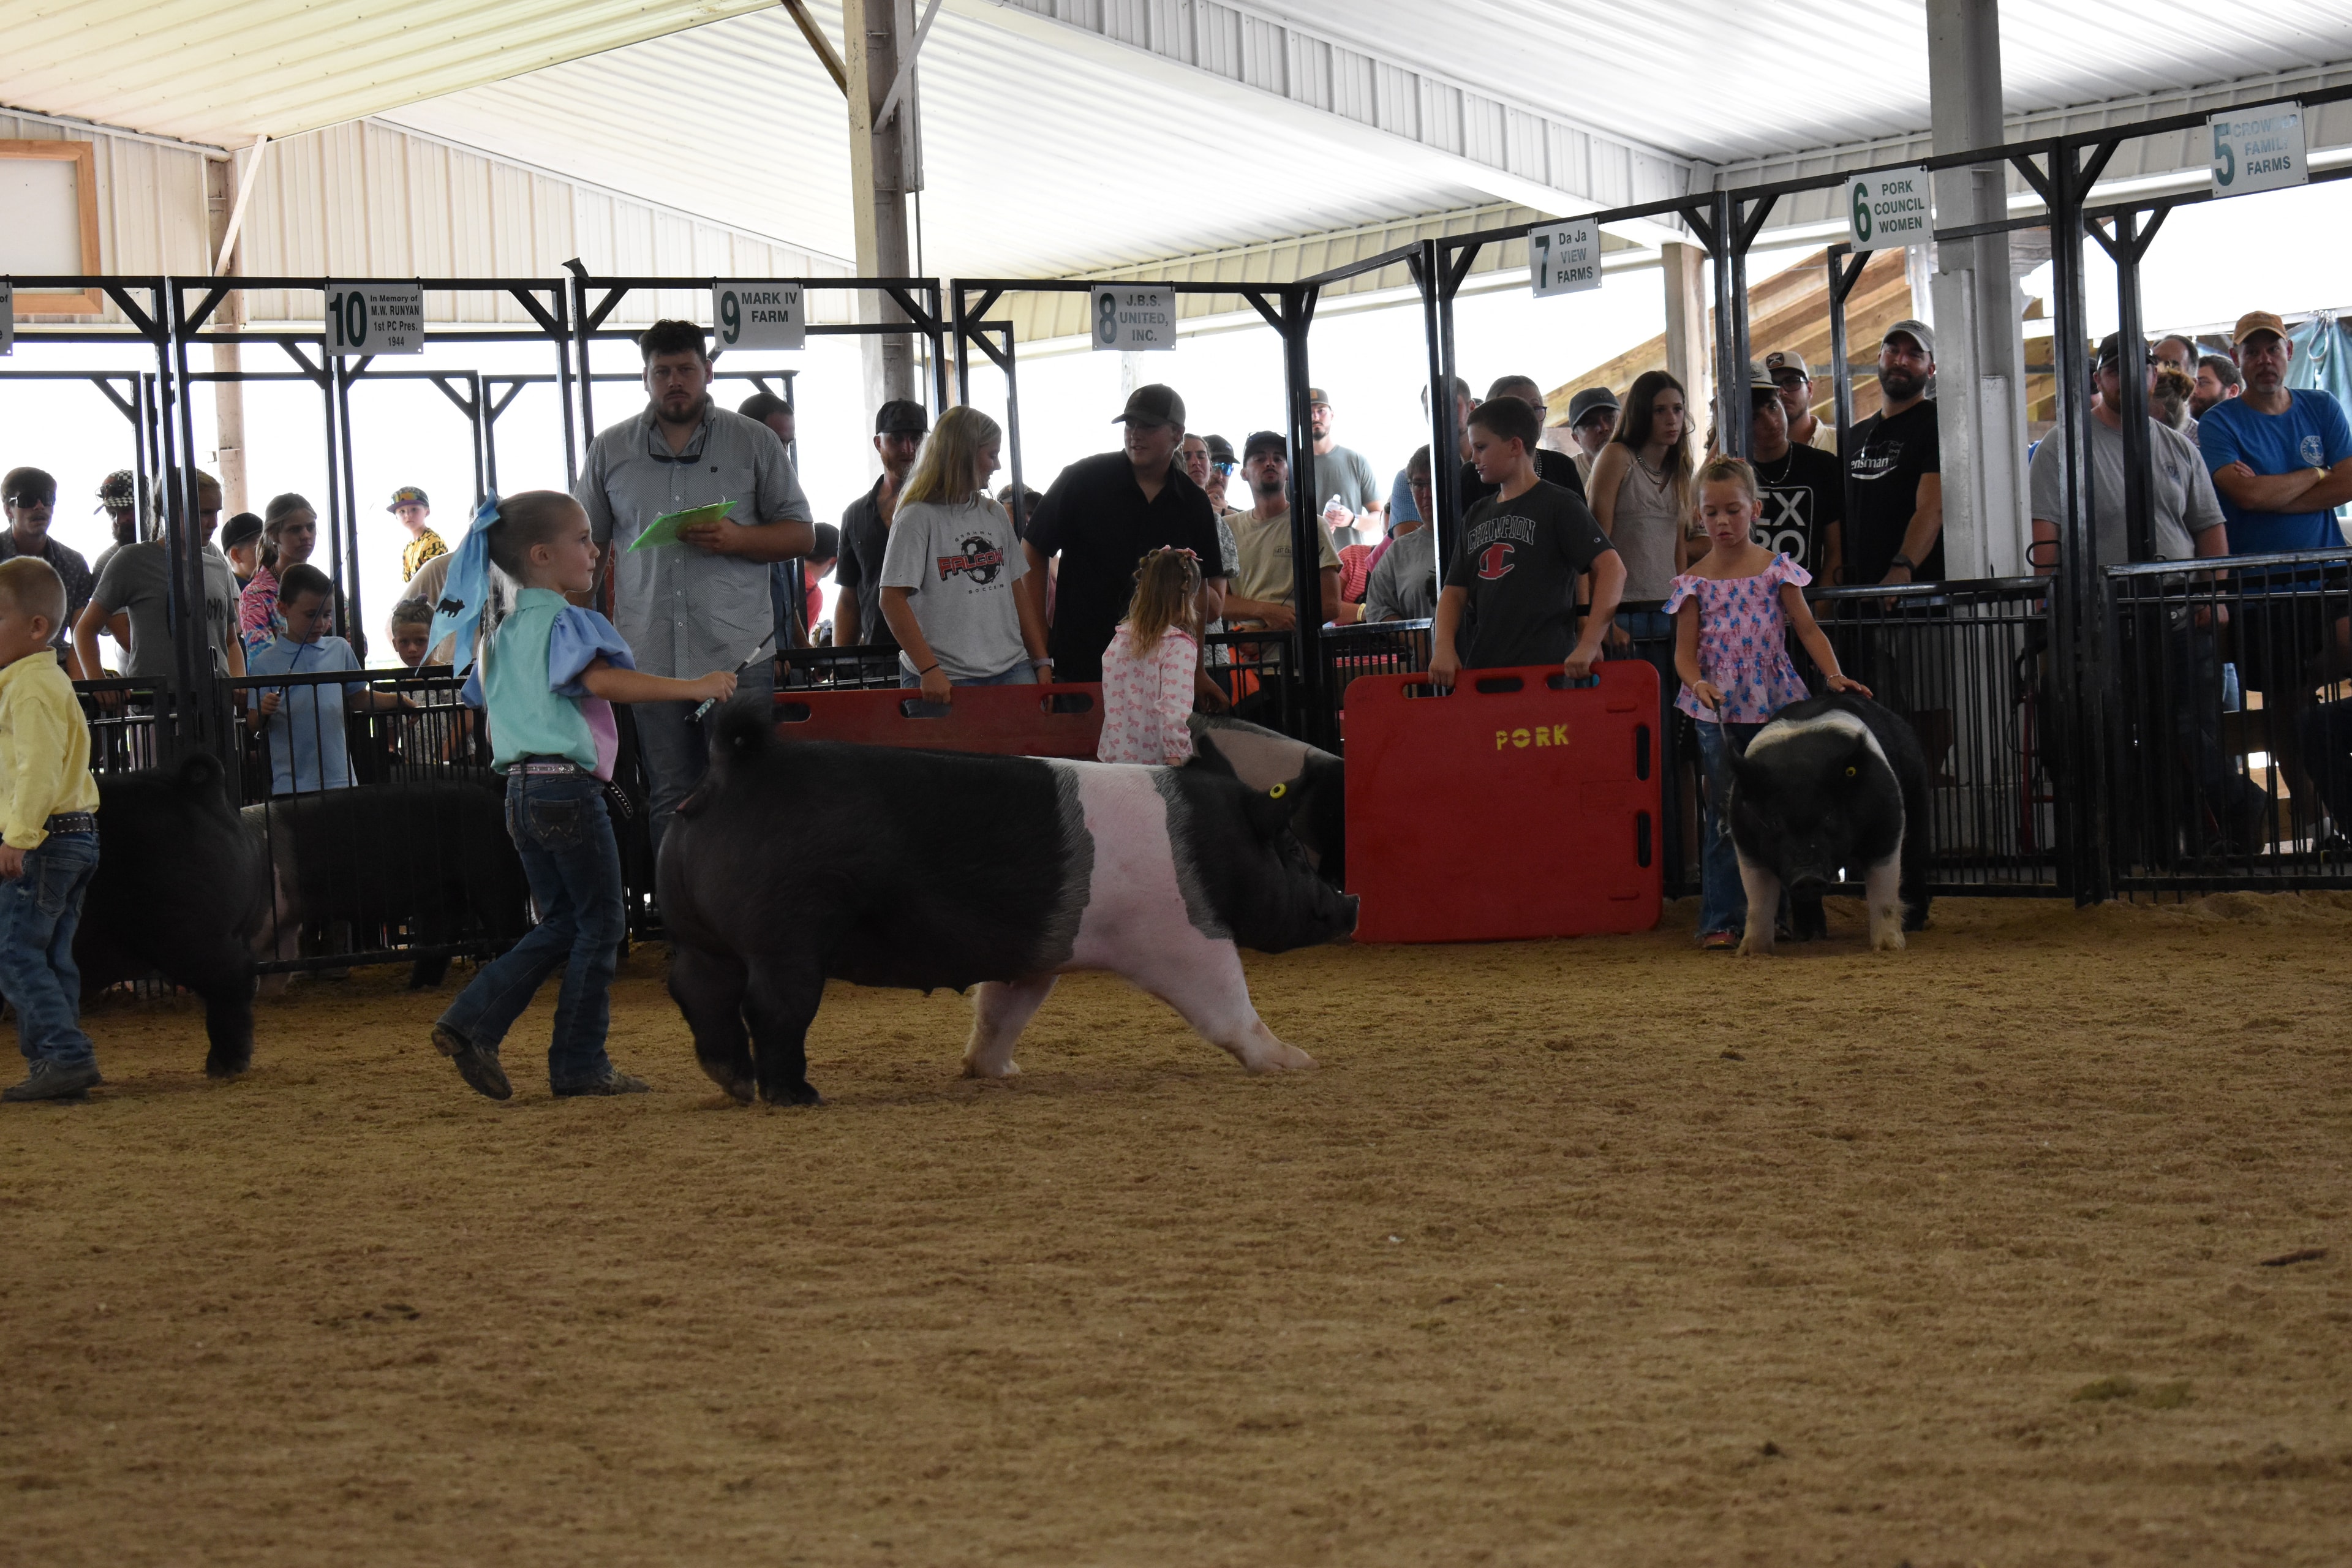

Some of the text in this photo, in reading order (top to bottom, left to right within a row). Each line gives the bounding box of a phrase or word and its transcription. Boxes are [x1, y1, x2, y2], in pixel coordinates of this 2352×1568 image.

[2233, 114, 2297, 138] CROWER
[2214, 123, 2235, 186] 5
[2245, 137, 2288, 156] FAMILY
[2247, 156, 2291, 175] FARMS
[1882, 180, 1913, 195] PORK
[1853, 182, 1872, 243] 6
[1874, 197, 1924, 216] COUNCIL
[1879, 216, 1922, 233] WOMEN
[1559, 230, 1586, 245] Da Ja
[1535, 235, 1550, 289] 7
[1561, 247, 1586, 264] VIEW
[1557, 266, 1593, 284] FARMS
[741, 292, 797, 304] MARK IV
[1126, 295, 1161, 306] J.B.S.
[371, 305, 420, 315] M.W. RUNYAN
[721, 290, 741, 344] 9
[752, 311, 788, 322] FARM
[1099, 293, 1117, 344] 8
[330, 291, 367, 347] 10
[374, 321, 418, 331] 1st PC Pres.
[1120, 312, 1168, 326] UNITED,
[388, 337, 404, 347] 1944
[1132, 330, 1157, 341] INC.
[1468, 514, 1536, 554] CHAMPION
[968, 584, 1004, 595] SOCCER
[1496, 723, 1569, 750] PORK
